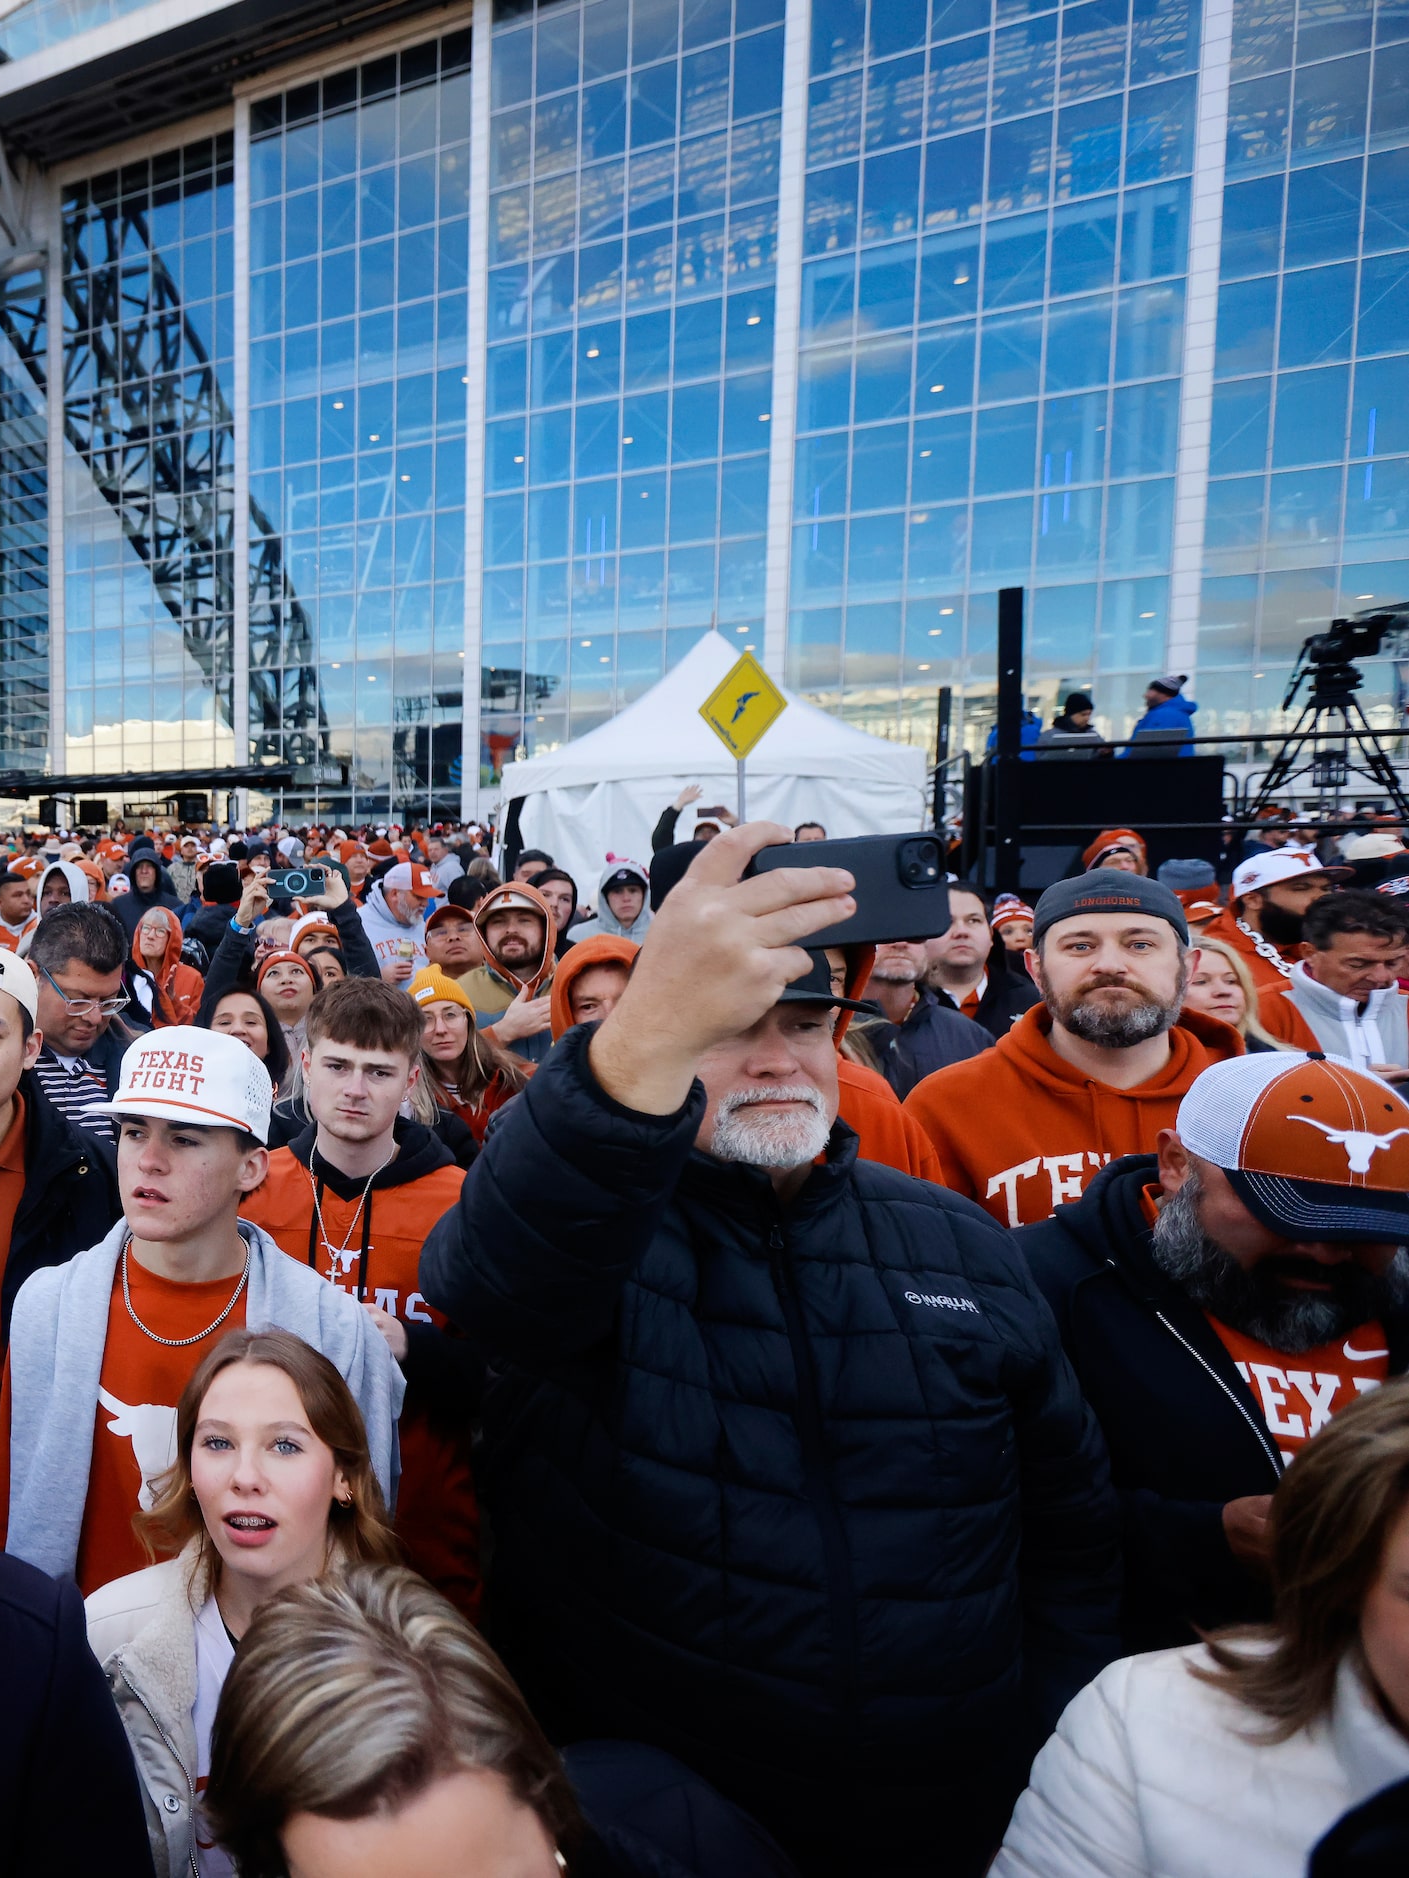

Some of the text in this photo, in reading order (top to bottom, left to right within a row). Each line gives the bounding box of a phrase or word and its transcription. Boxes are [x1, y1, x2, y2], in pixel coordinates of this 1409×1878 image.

[1074, 896, 1141, 908] LONGHORNS
[375, 938, 426, 960] TEA
[138, 1050, 204, 1073] TEXAS
[129, 1071, 205, 1095] FIGHT
